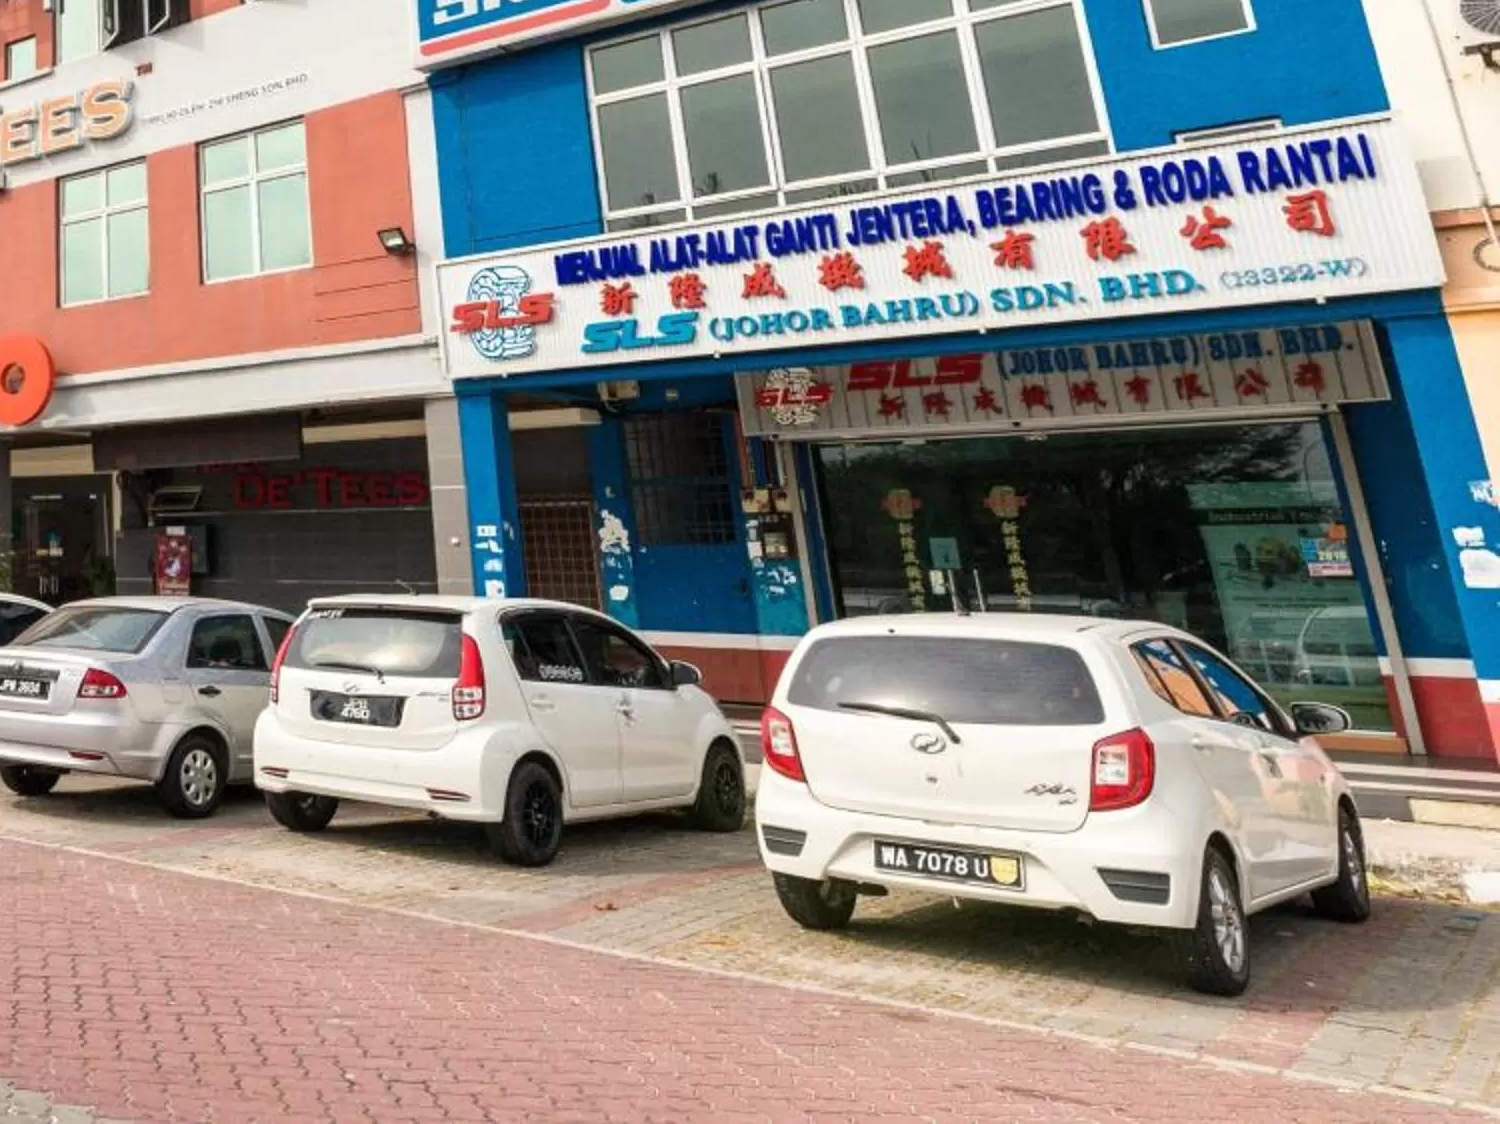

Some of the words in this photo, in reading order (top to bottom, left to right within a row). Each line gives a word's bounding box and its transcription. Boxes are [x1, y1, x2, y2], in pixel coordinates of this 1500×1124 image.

[650, 224, 760, 273] ALAT-ALAT
[765, 212, 841, 258] GANTI
[846, 194, 978, 247] JENTERA,
[975, 172, 1106, 230] BEARING
[1113, 169, 1137, 211] &
[1140, 156, 1234, 208] RODA
[1237, 133, 1377, 195] RANTAI
[450, 292, 555, 334] SLS
[581, 310, 701, 354] SLS
[710, 307, 836, 342] (JOHOR
[838, 289, 980, 327] BAHRU)
[989, 279, 1088, 313] SDN.
[1099, 268, 1206, 303] BHD.
[1220, 256, 1369, 290] (13322-W)
[848, 352, 984, 391] SLS
[997, 346, 1090, 382] (JOHOR
[1096, 334, 1201, 370] BAHRU)
[1207, 330, 1274, 362] SDN.
[1279, 325, 1354, 354] BHD.
[754, 382, 834, 408] SLS
[880, 845, 909, 868] WA
[914, 851, 970, 876] 7078
[974, 858, 989, 878] U
